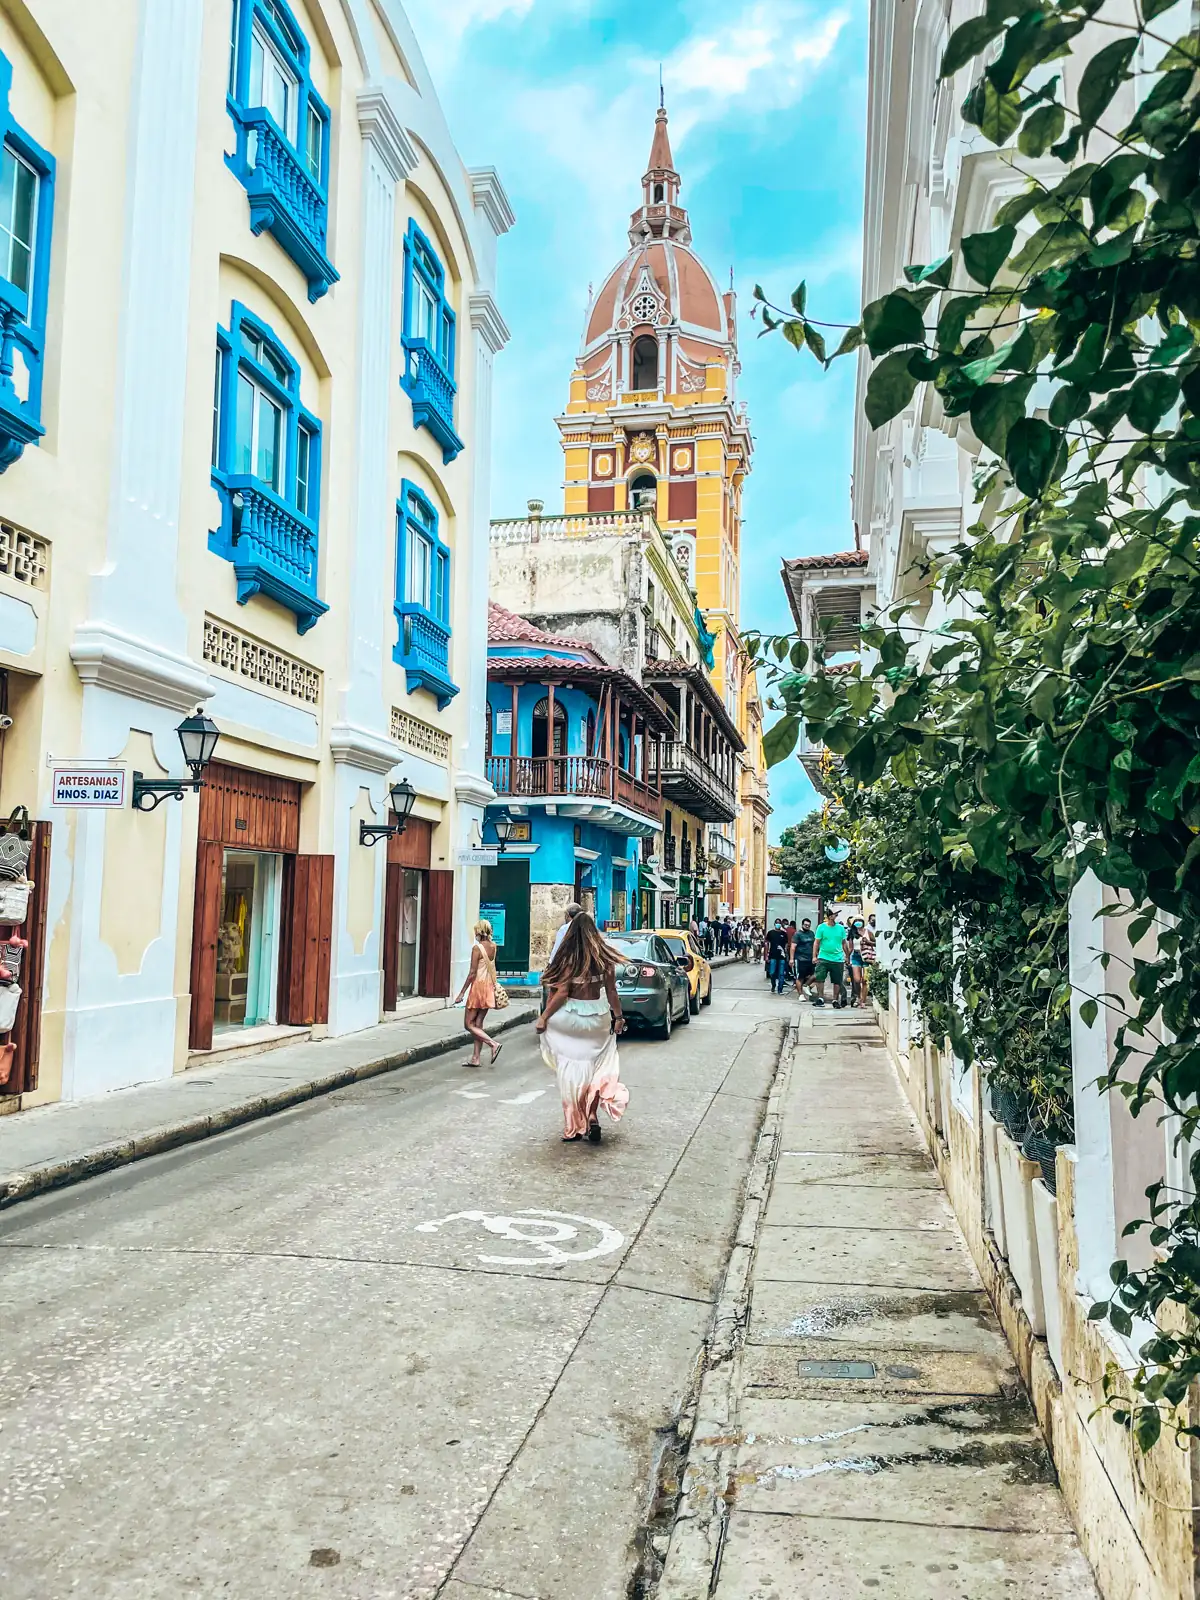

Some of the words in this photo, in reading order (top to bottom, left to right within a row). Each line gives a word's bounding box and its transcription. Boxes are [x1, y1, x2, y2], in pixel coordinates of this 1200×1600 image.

[59, 776, 118, 786] ARTESANIAS
[57, 789, 90, 799] HNOS.
[93, 790, 119, 800] DIAZ
